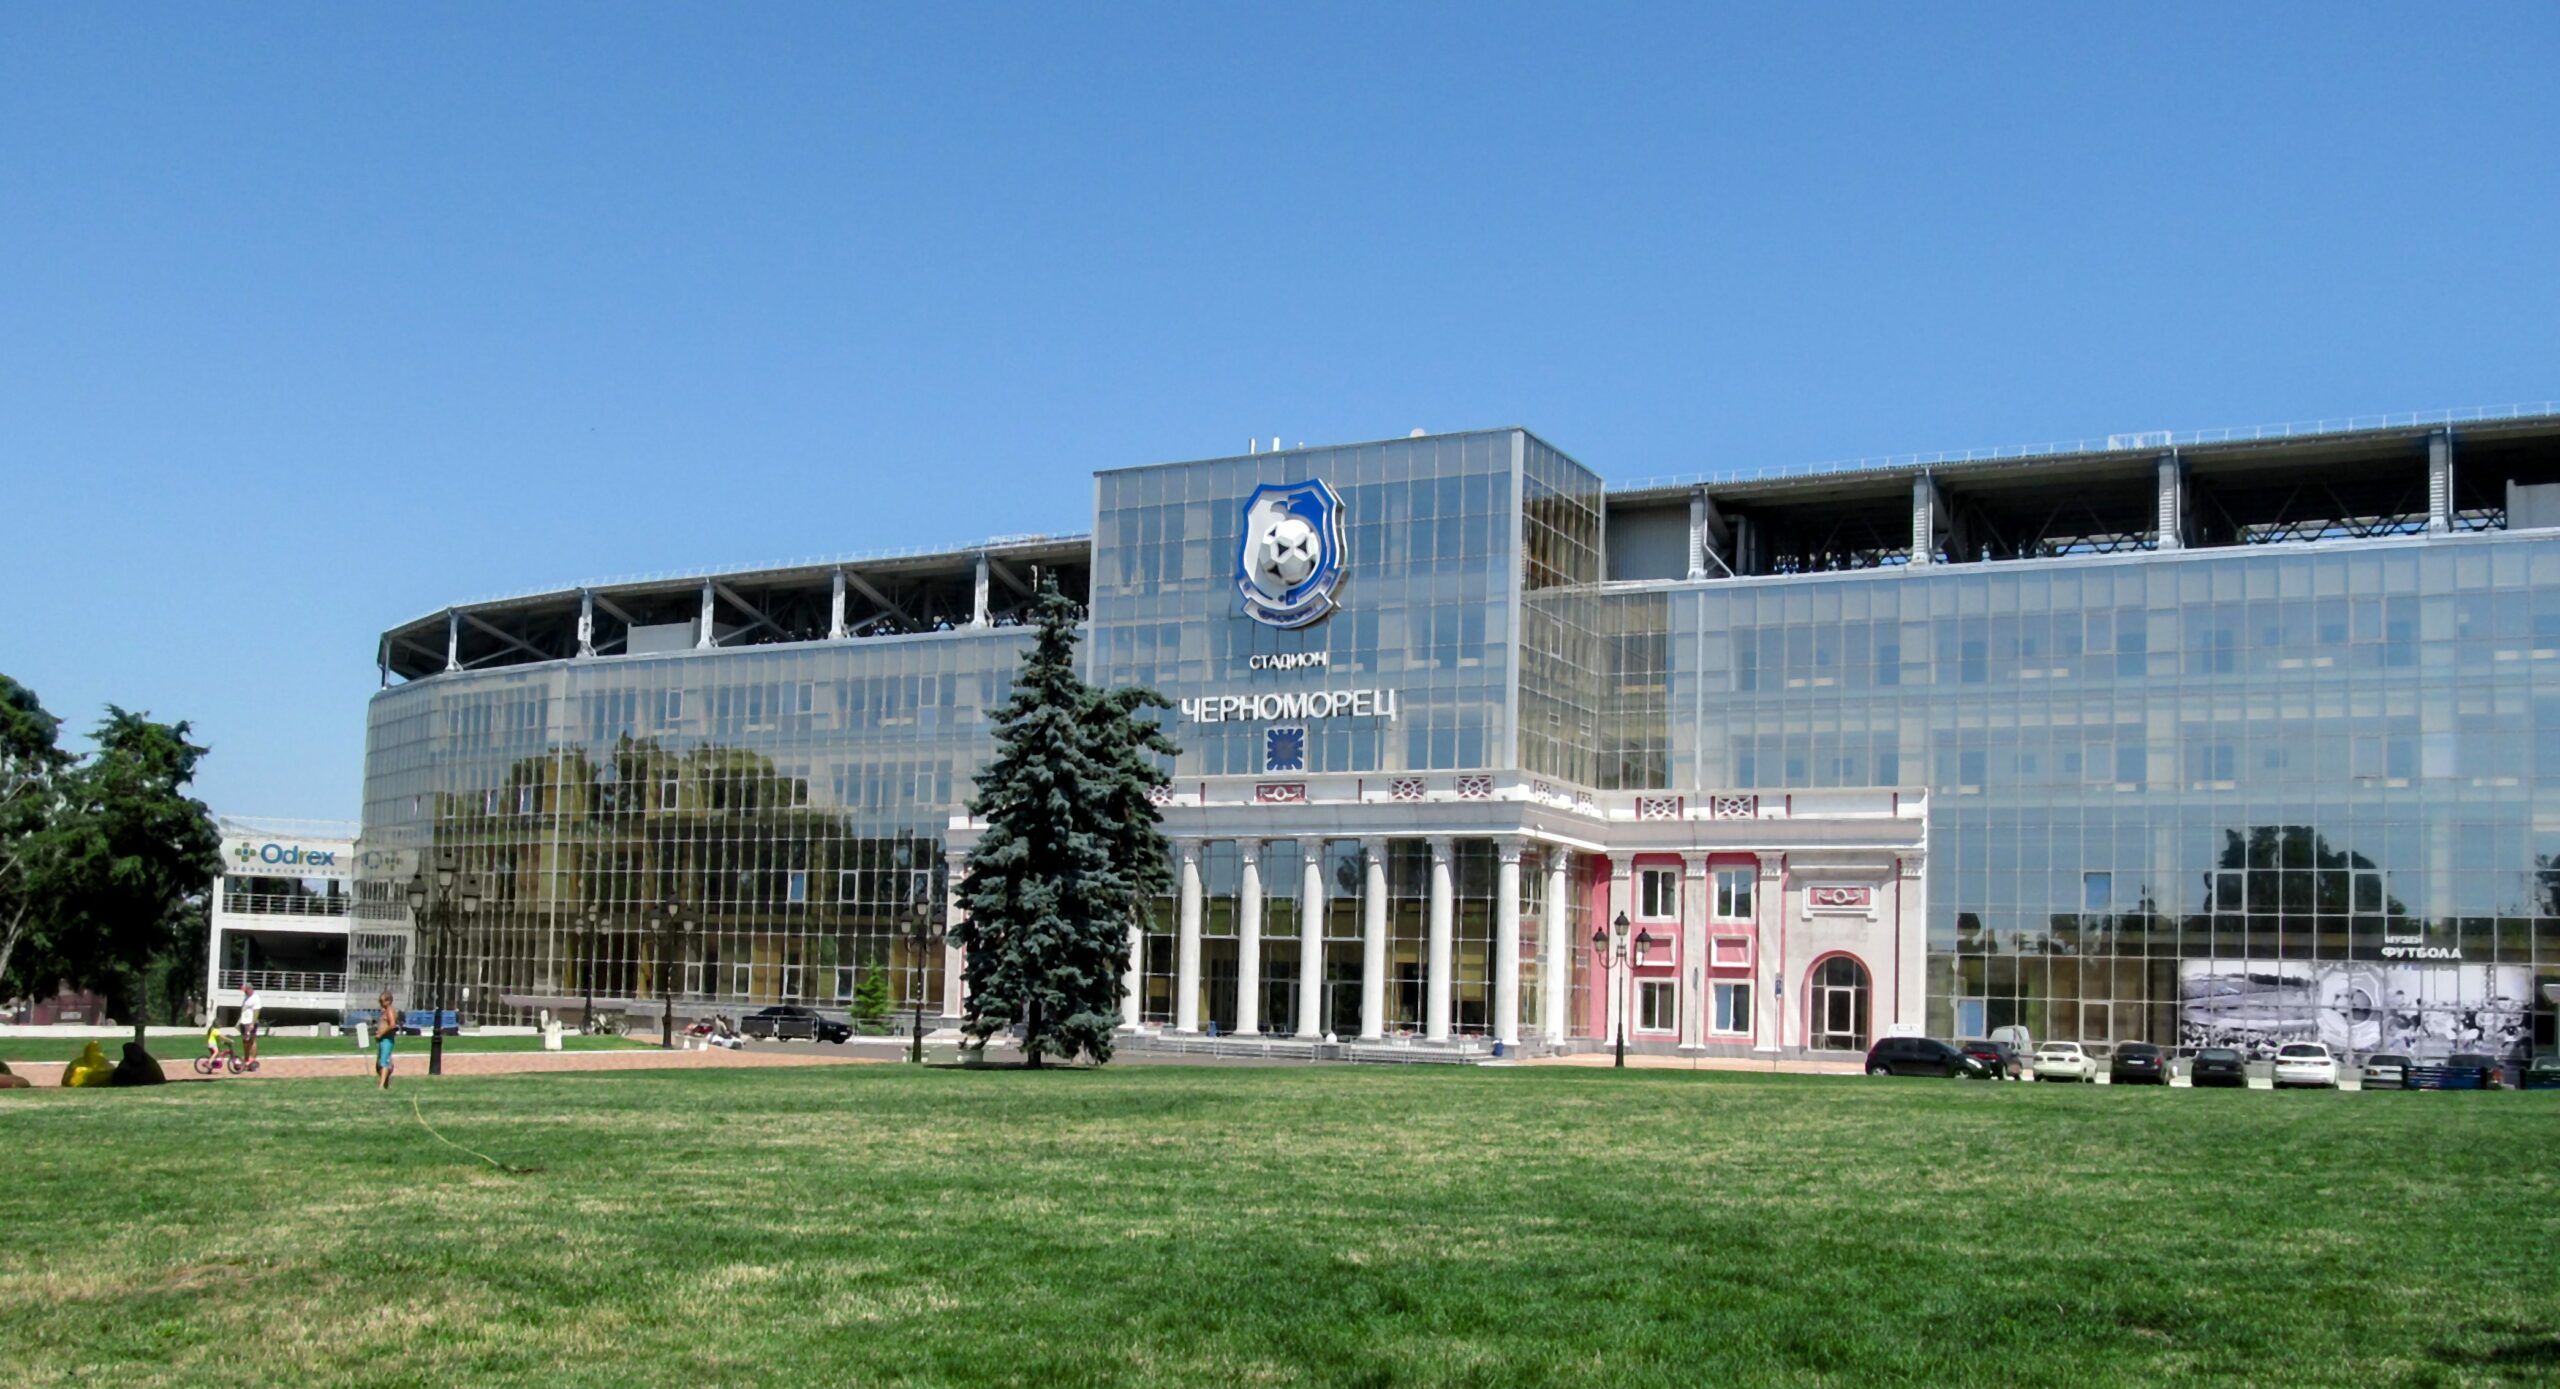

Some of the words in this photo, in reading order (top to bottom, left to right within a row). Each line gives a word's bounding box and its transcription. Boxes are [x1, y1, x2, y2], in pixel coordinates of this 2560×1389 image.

[1249, 651, 1327, 670] СТАДИОН
[1180, 688, 1398, 724] ЧЕРНОМОРЕЦ
[260, 843, 335, 866] Odrex
[2381, 946, 2462, 958] ФУТБОЛА
